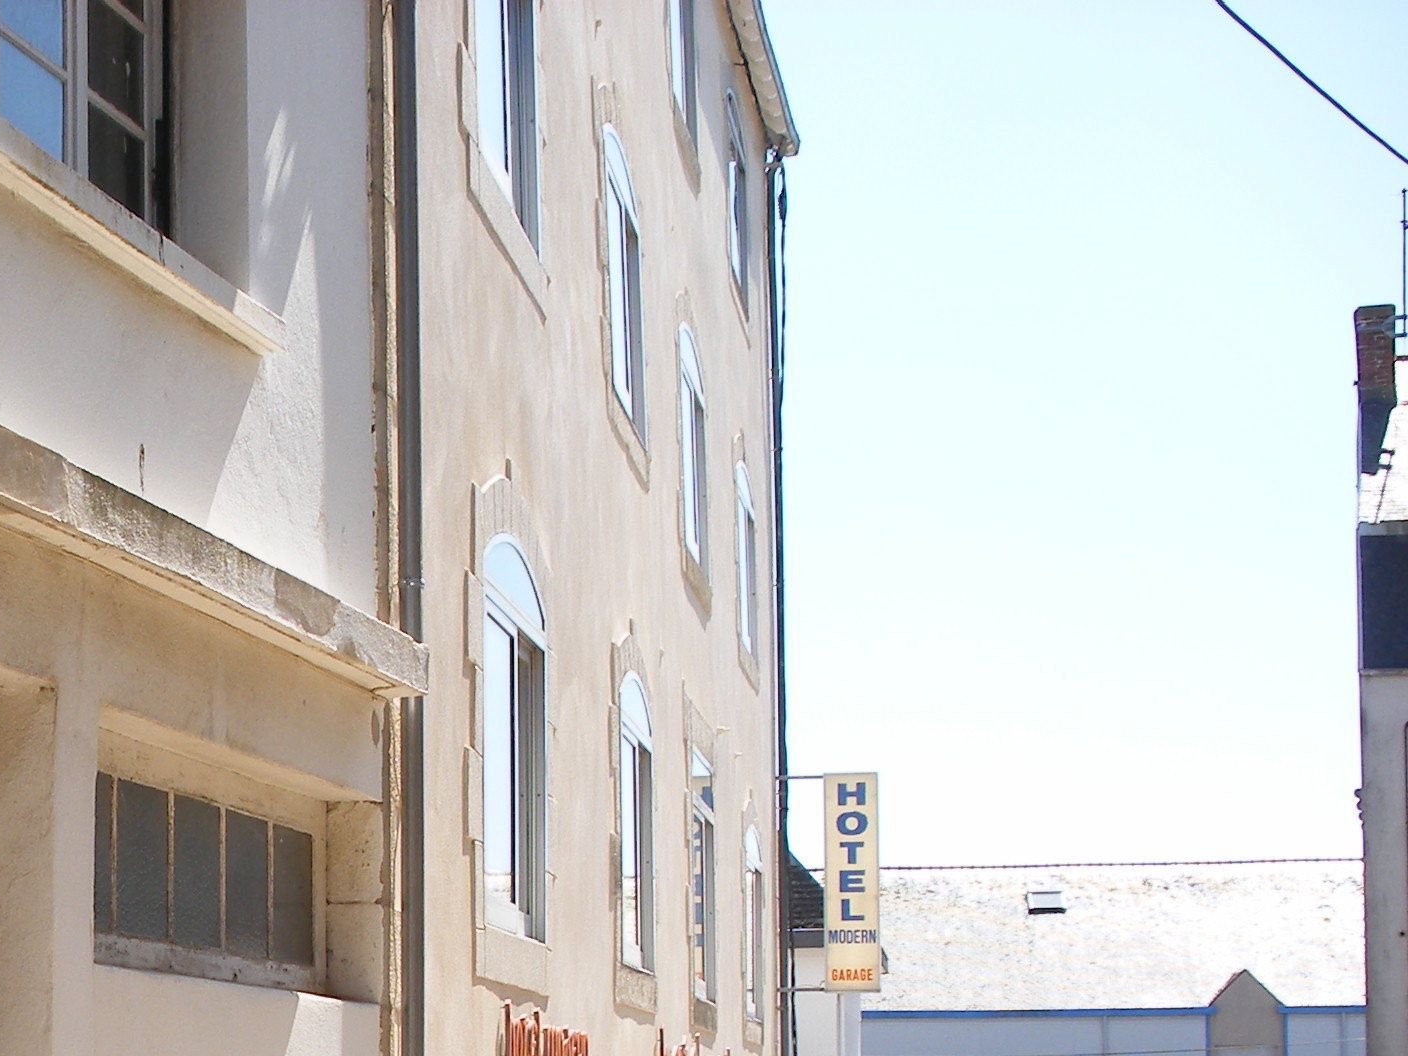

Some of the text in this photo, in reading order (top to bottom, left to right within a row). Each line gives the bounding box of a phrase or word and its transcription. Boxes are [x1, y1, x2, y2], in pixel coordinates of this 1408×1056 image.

[835, 782, 868, 922] HOTEL
[828, 929, 876, 944] MODERN
[831, 968, 873, 981] GARAGE
